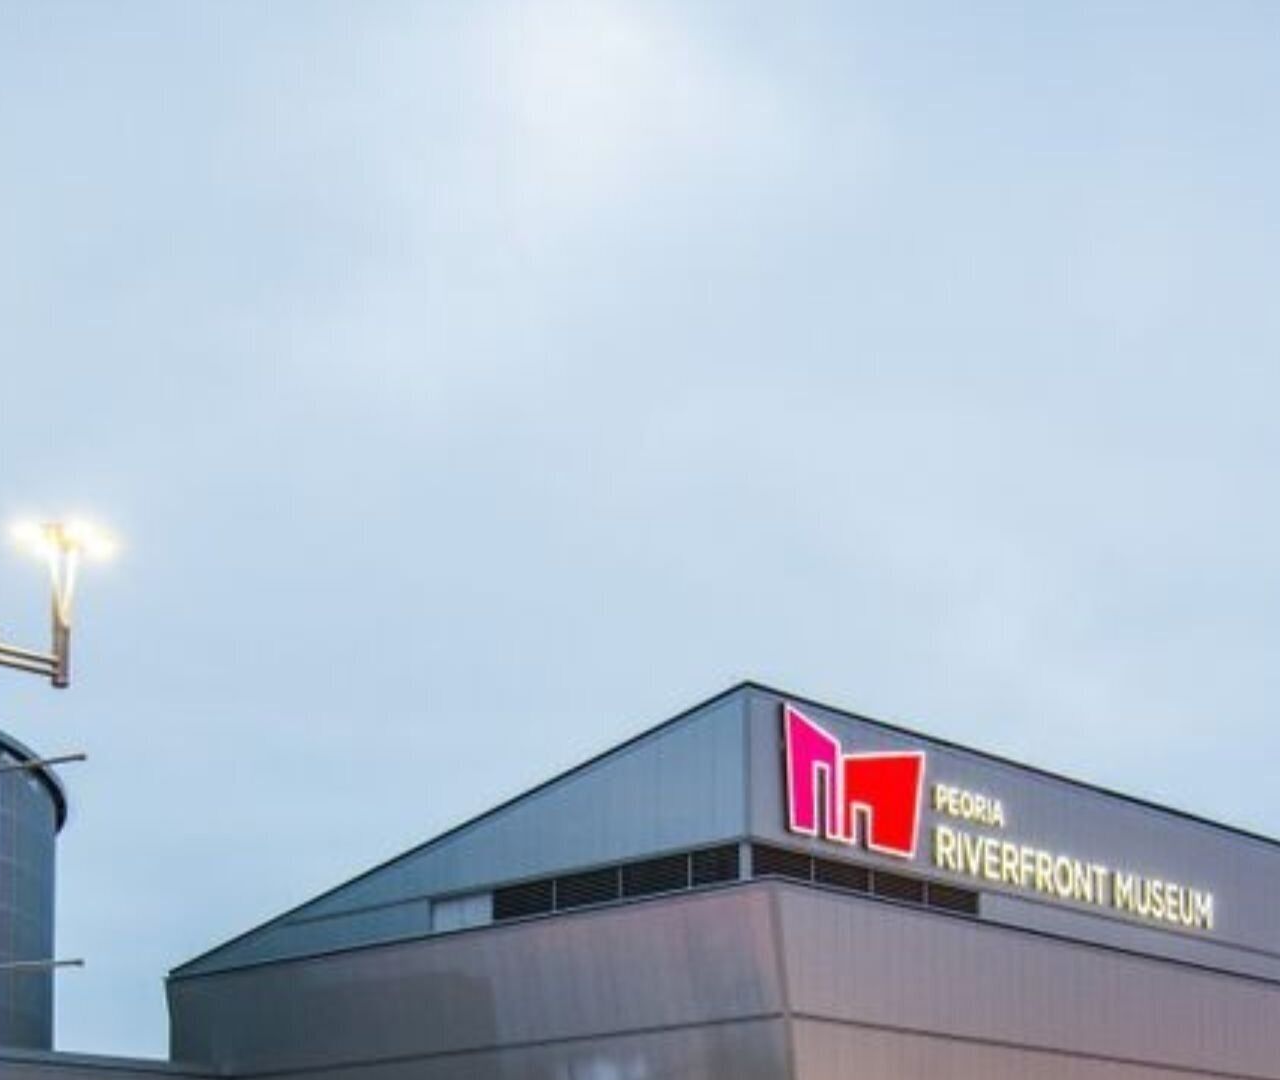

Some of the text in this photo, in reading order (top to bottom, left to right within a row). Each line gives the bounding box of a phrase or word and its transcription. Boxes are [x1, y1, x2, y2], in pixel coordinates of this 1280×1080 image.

[935, 785, 1004, 826] PEORIA
[935, 826, 1215, 929] RIVERFRONT MUSEUM
